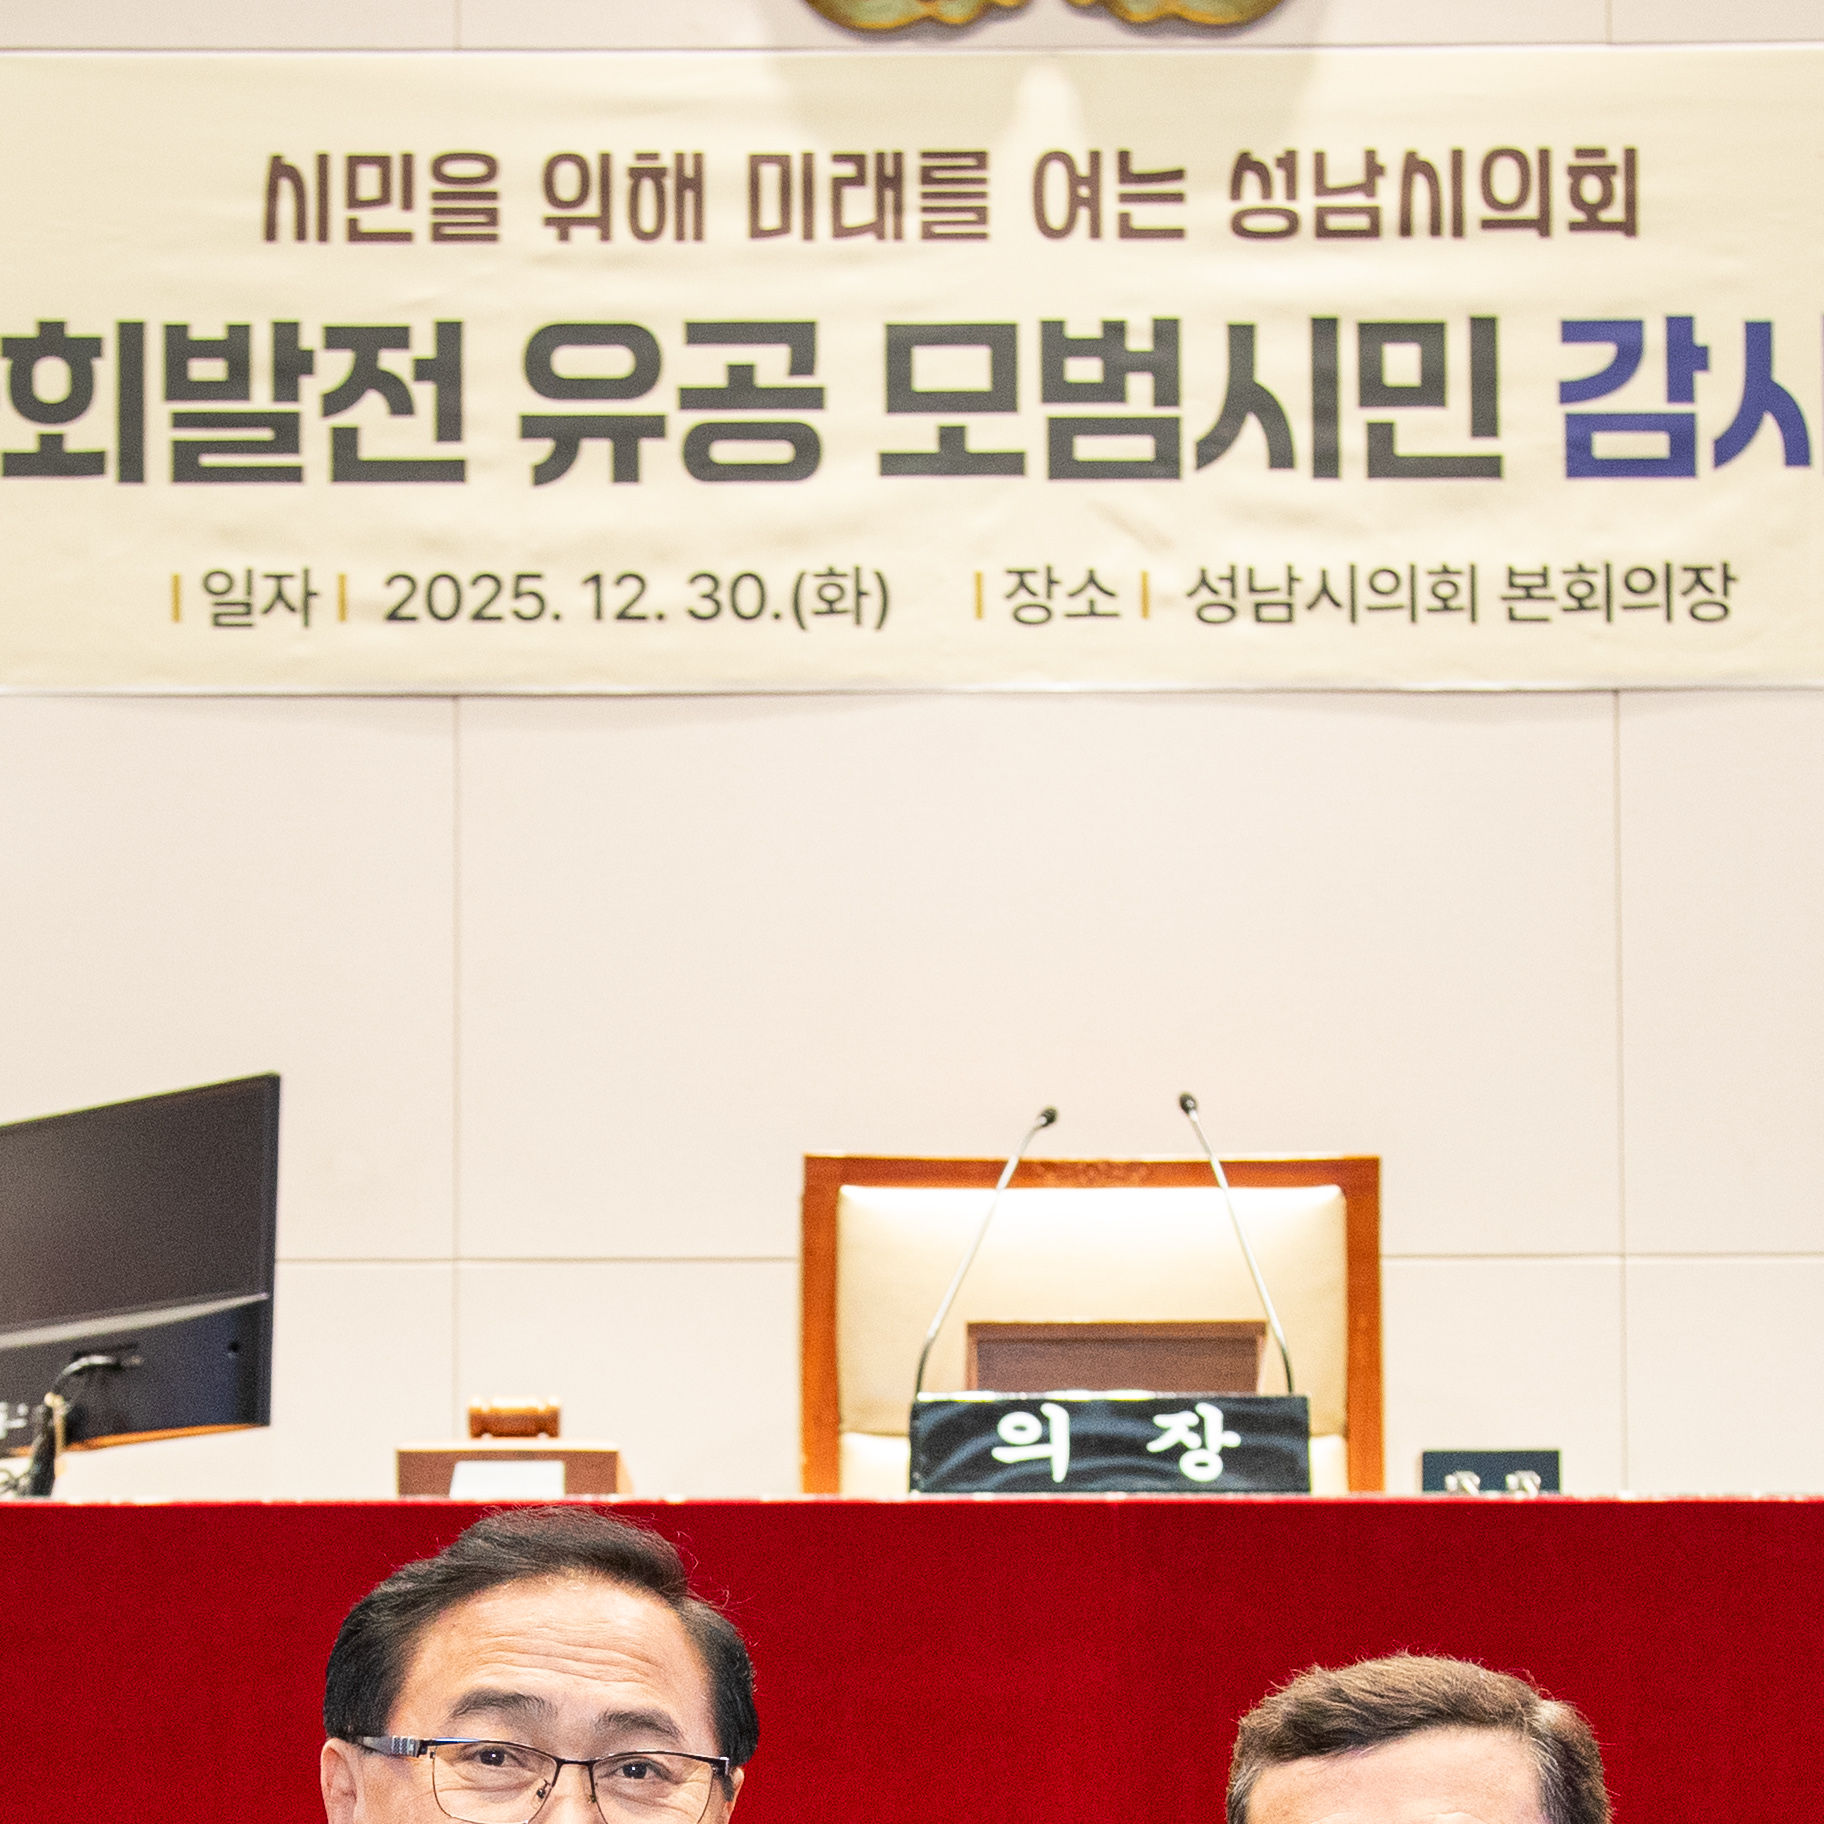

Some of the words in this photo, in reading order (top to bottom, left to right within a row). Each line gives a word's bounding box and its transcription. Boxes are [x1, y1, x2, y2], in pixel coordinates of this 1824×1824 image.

[263, 151, 500, 244] 시민을
[541, 151, 705, 243] 위해
[747, 149, 989, 242] 미래를
[1032, 148, 1187, 241] 여는
[1229, 146, 1639, 241] 성남시의회
[519, 320, 826, 487] 유공
[878, 315, 1504, 481] 모범시민
[201, 568, 320, 630] 일자
[383, 571, 562, 624] 2025.
[582, 571, 666, 623] 12.
[686, 566, 890, 631] 30.(화)
[1005, 565, 1120, 627] 장소
[1186, 563, 1478, 626] 성남시의회
[1500, 560, 1738, 624] 본회의장
